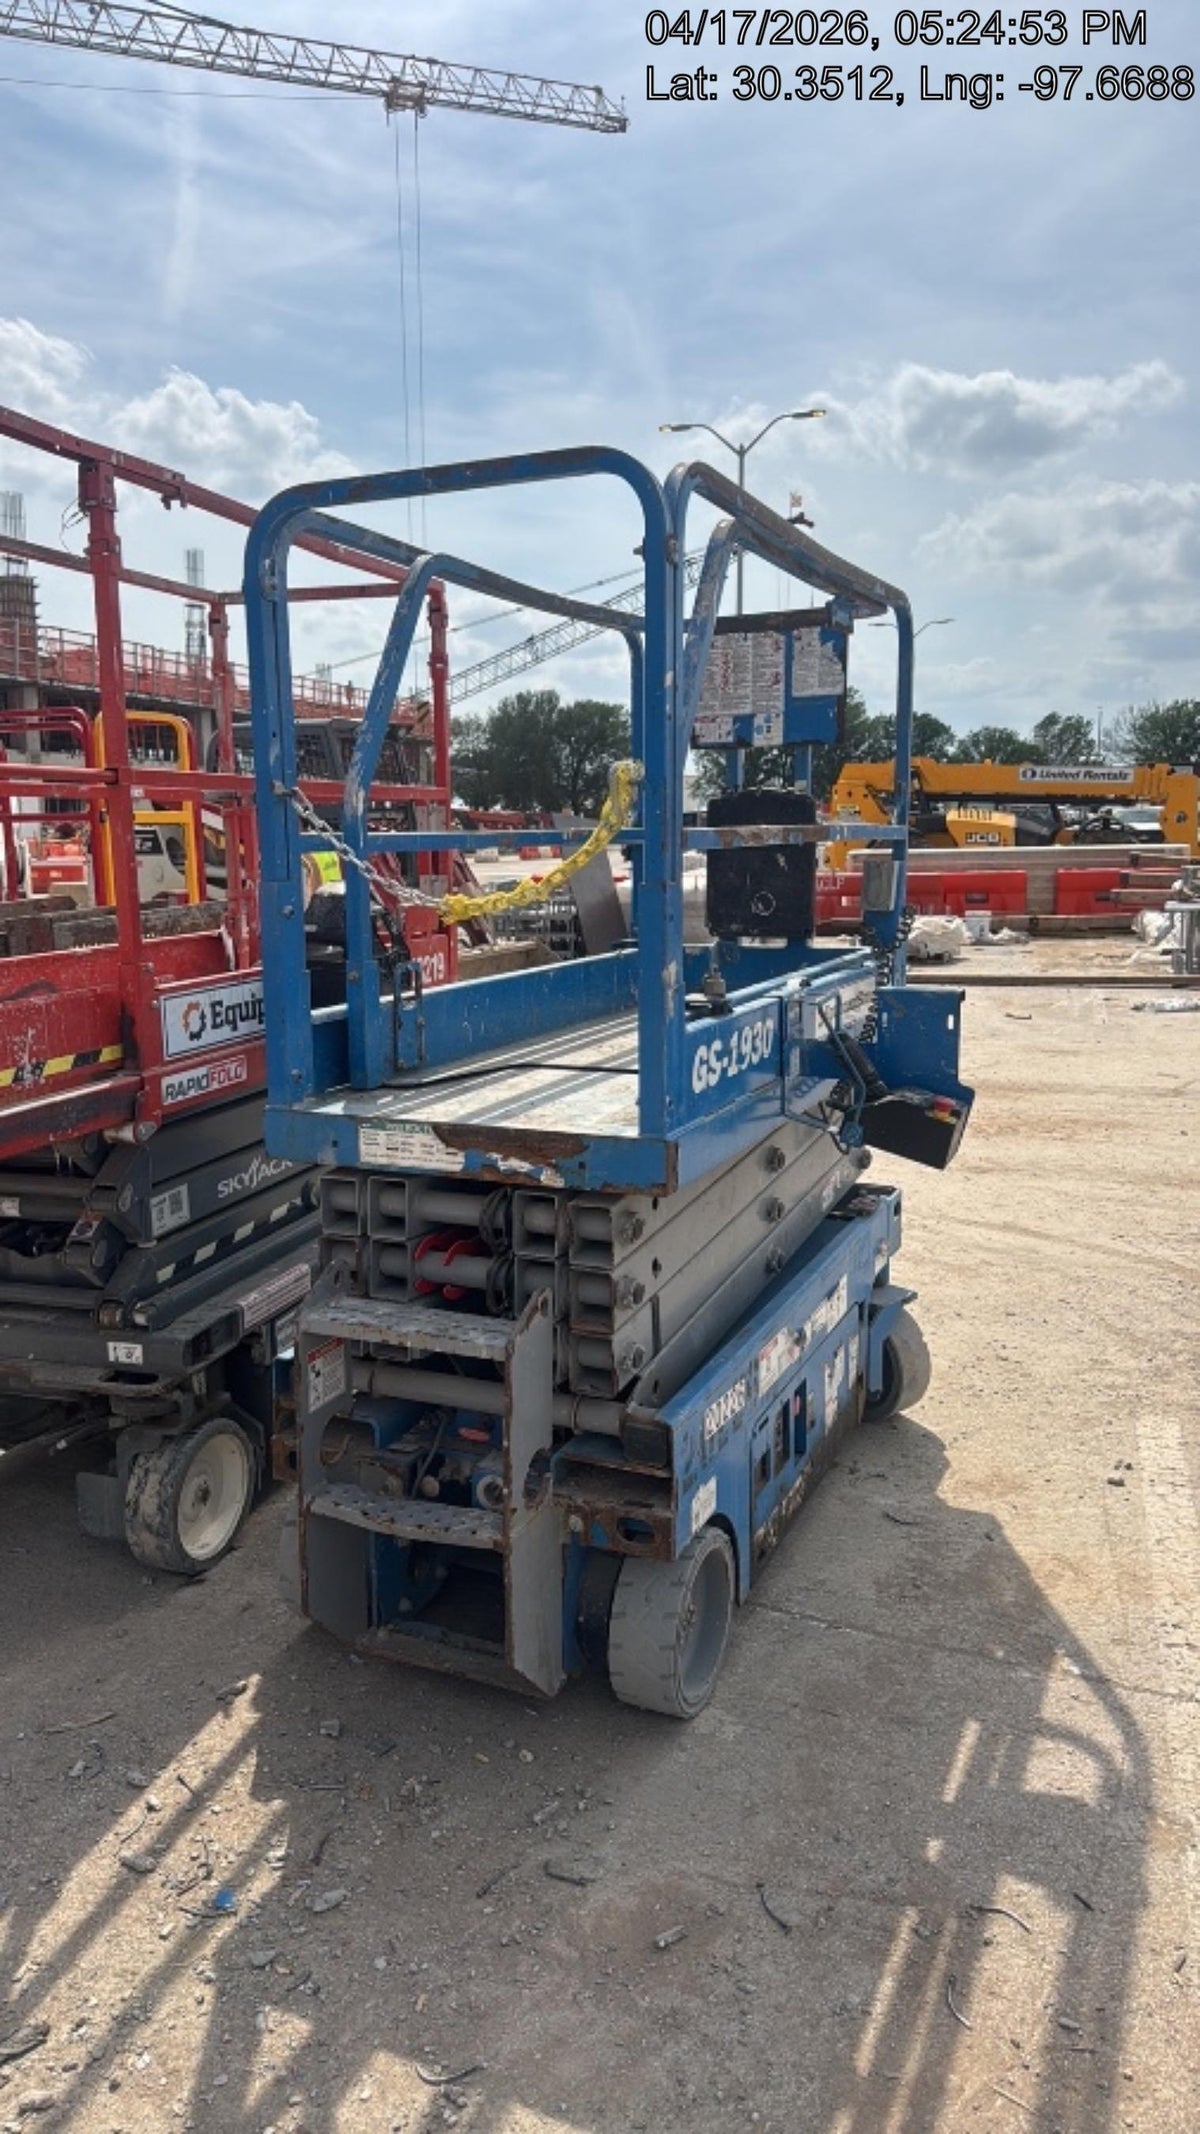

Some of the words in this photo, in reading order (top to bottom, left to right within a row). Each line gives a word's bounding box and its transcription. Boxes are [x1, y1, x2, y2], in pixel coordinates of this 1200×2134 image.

[1040, 769, 1082, 780] United
[1083, 769, 1131, 781] Rentals
[692, 1018, 775, 1094] GS-1930
[164, 1060, 244, 1101] RAPIDFOLD
